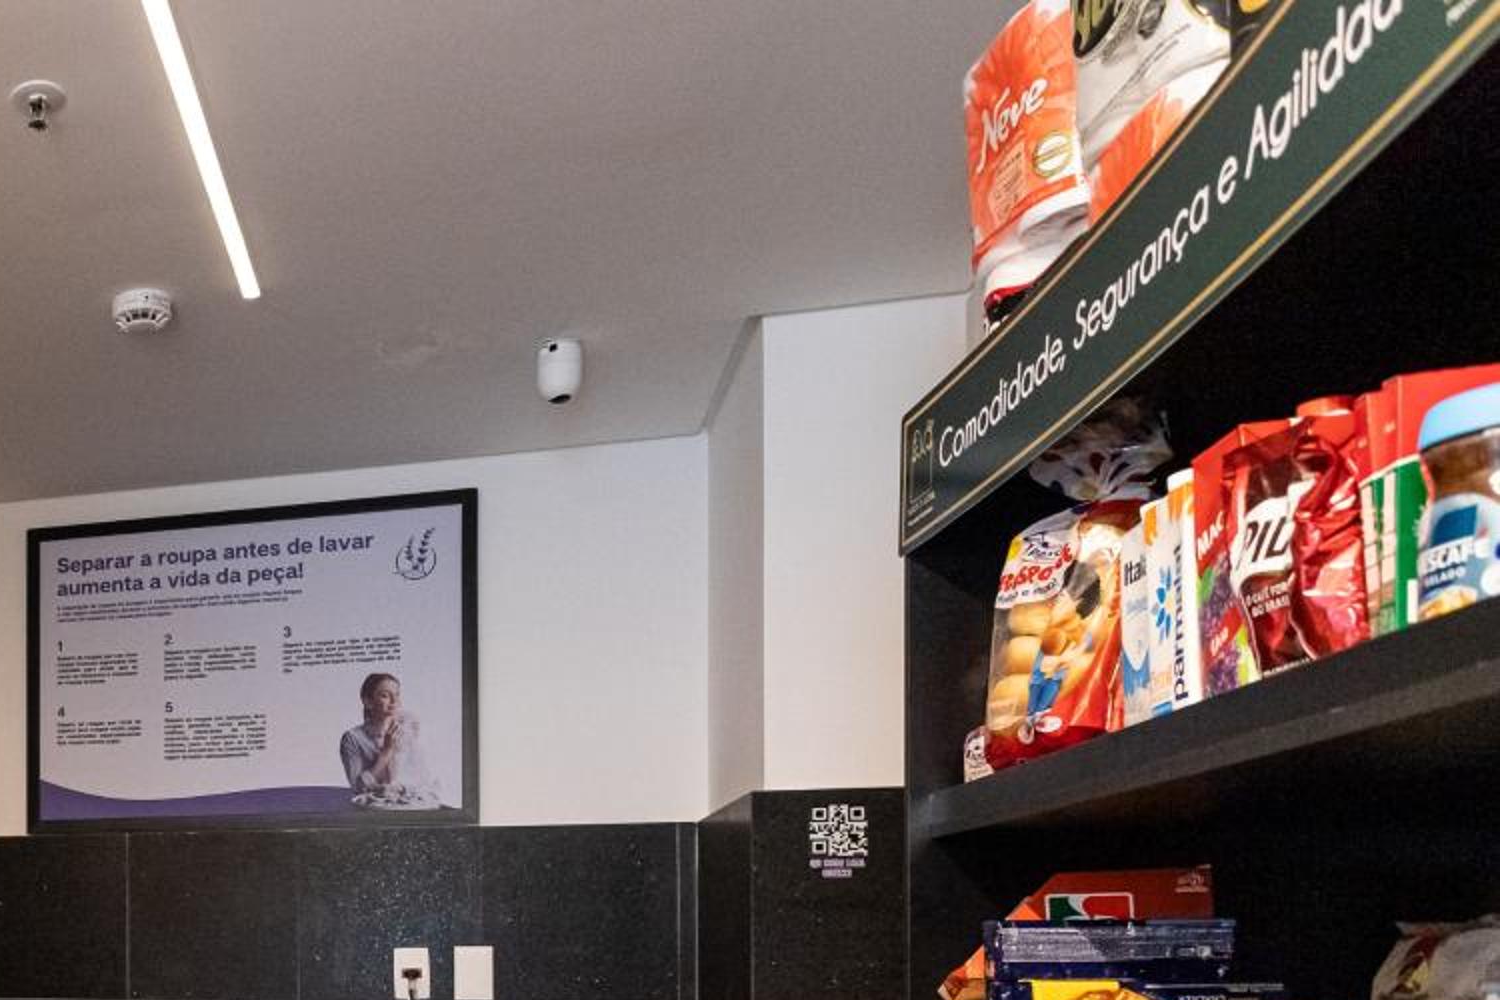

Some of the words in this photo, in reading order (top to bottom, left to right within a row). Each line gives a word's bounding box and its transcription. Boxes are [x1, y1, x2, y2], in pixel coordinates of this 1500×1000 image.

[975, 78, 1048, 175] Neve
[938, 335, 1066, 468] Comodidade,
[1073, 188, 1209, 351] Segurança
[1216, 156, 1238, 204] e
[57, 555, 134, 576] Separar
[140, 554, 152, 568] a
[157, 546, 217, 566] roupa
[223, 540, 281, 561] antes
[287, 537, 313, 556] de
[319, 533, 375, 553] lavar
[57, 574, 144, 597] aumenta
[149, 576, 162, 590] a
[167, 570, 210, 590] vida
[216, 565, 242, 585] da
[247, 562, 304, 586] peça!
[164, 634, 174, 645] 2
[283, 625, 292, 638] 3
[57, 706, 65, 718] 4
[165, 702, 173, 713] 5
